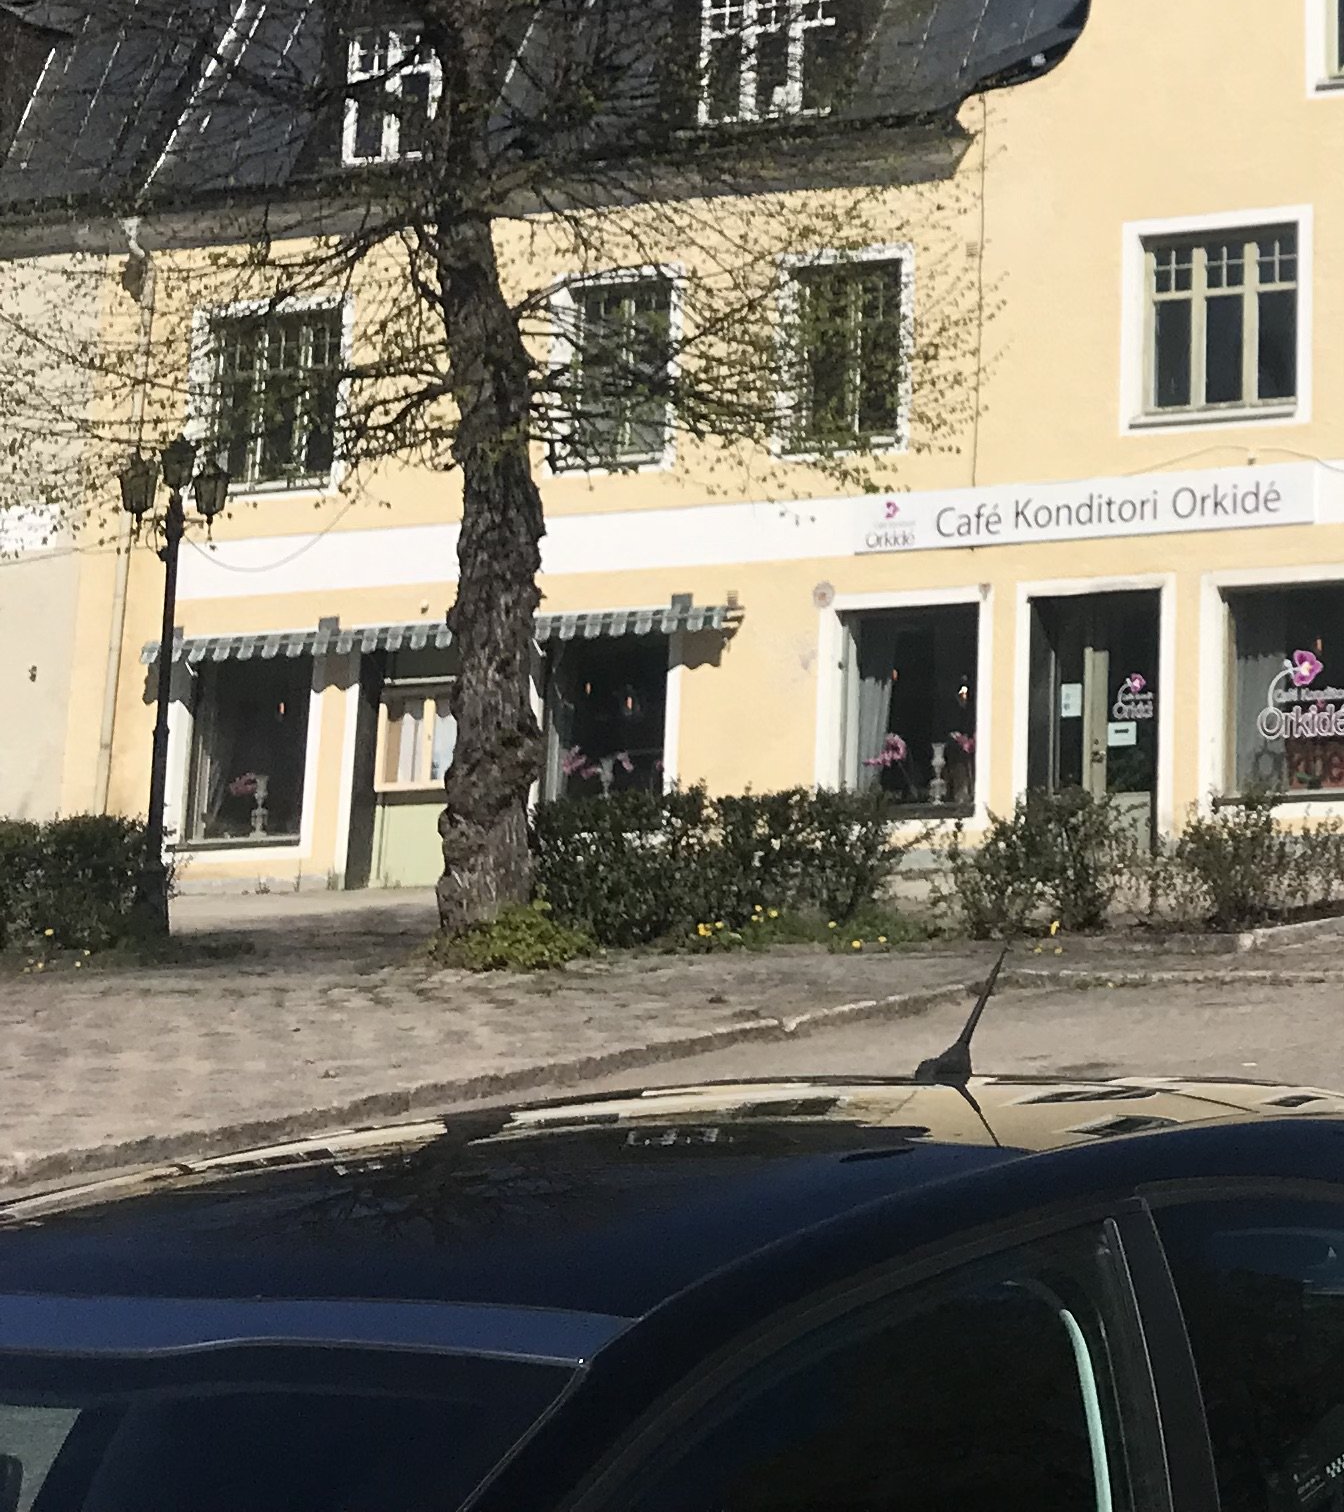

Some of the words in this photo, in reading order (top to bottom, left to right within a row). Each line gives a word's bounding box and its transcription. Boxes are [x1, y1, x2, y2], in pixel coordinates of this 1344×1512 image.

[936, 502, 1001, 538] Café
[1014, 489, 1158, 529] Konditori
[1172, 480, 1281, 519] Orkidé
